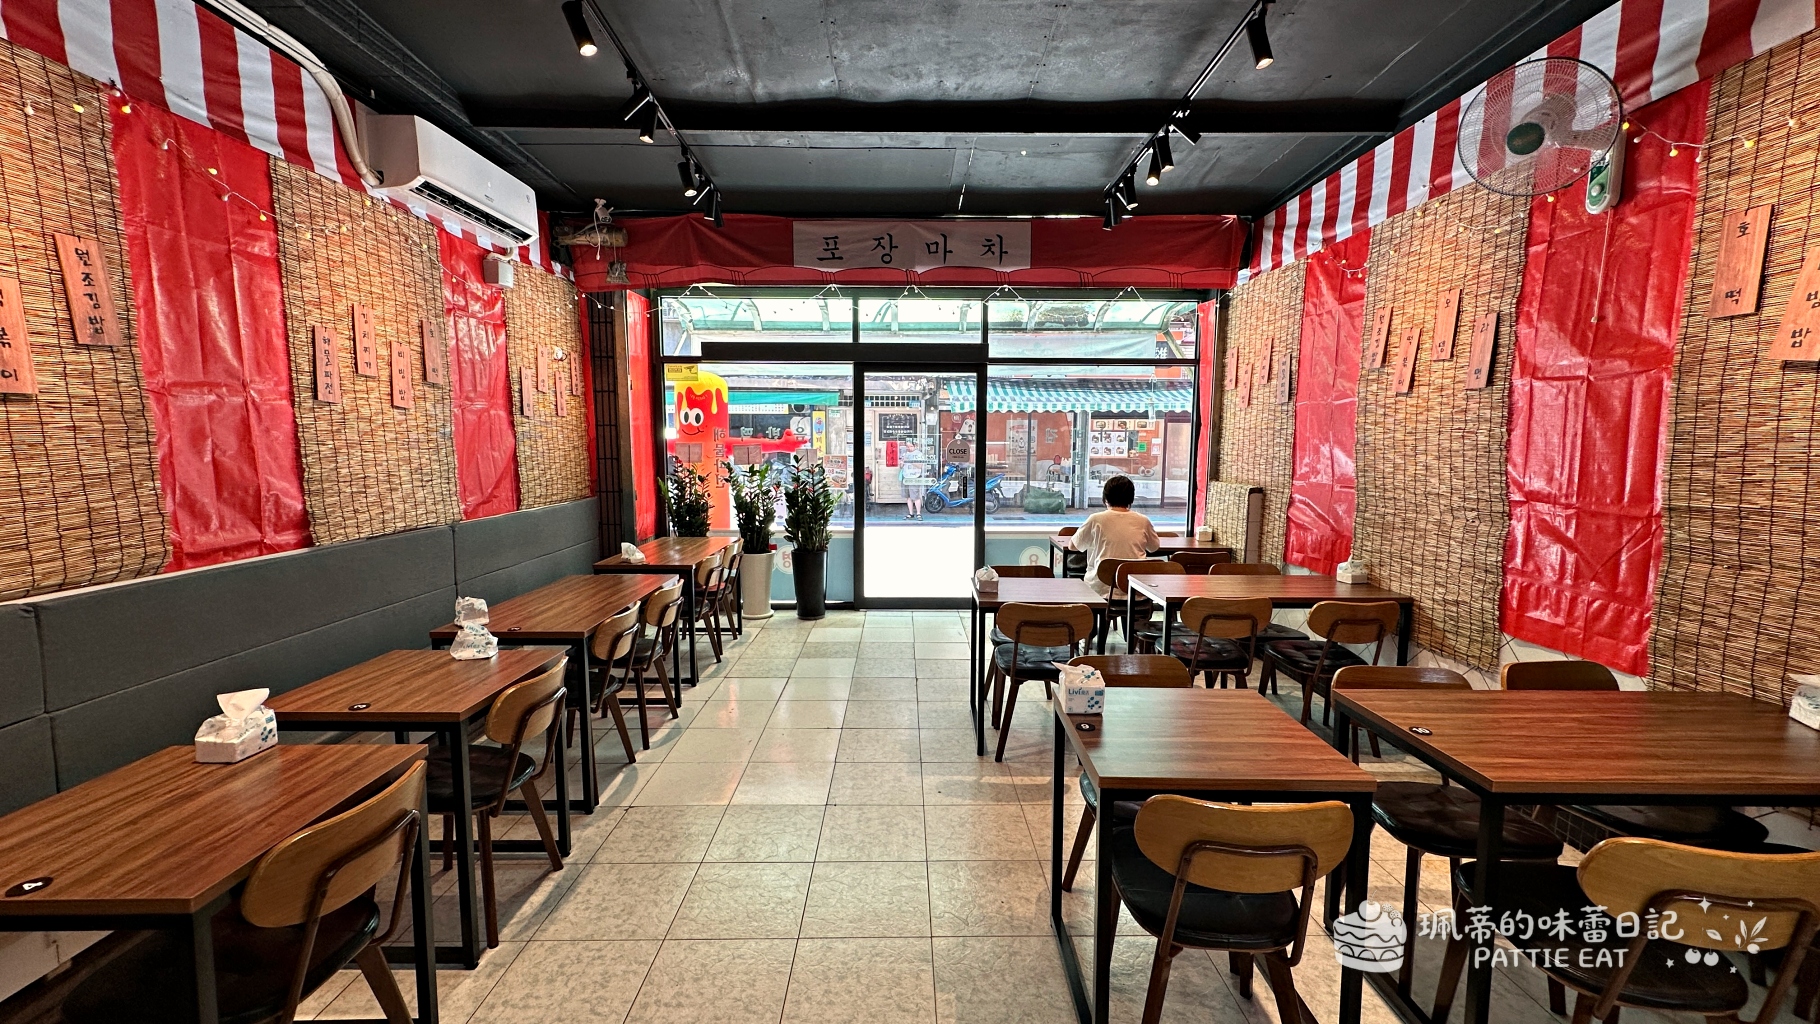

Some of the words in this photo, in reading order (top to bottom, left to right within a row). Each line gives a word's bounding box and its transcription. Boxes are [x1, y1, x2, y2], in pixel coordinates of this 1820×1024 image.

[816, 232, 1008, 265] 포장마차
[1725, 221, 1750, 305] 호떡
[74, 247, 106, 335] 원조김밥
[322, 336, 334, 395] 해물파전
[1474, 322, 1490, 380] 라면
[22, 881, 44, 891] 4
